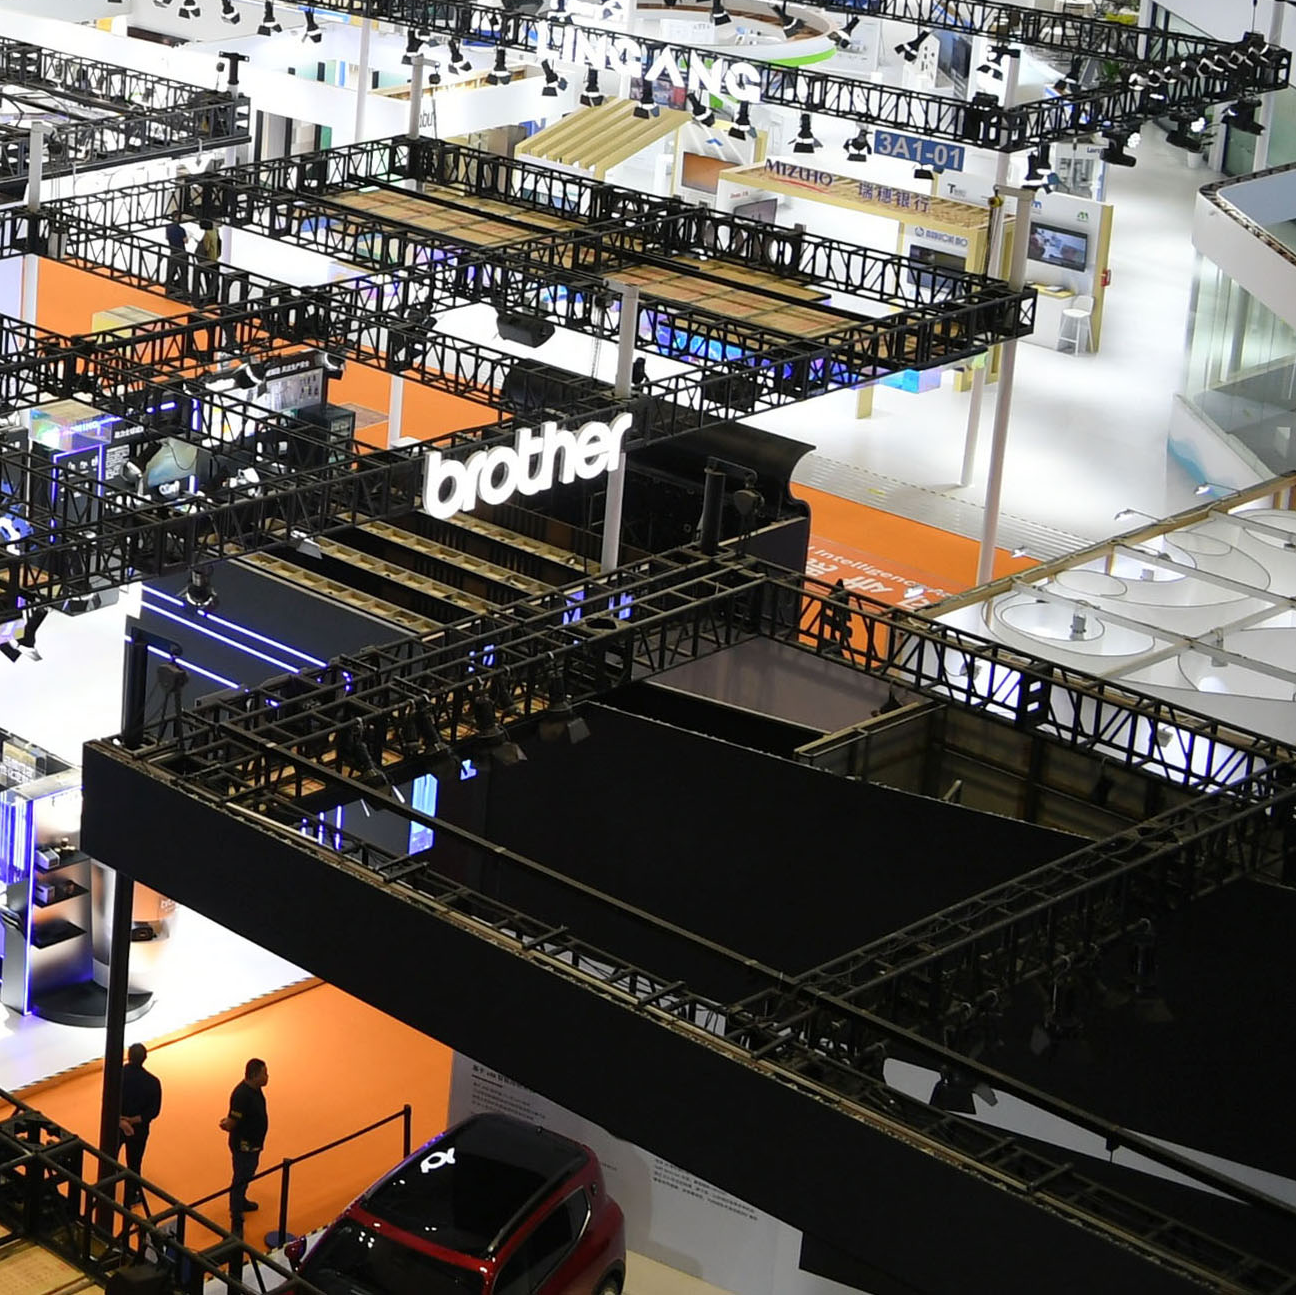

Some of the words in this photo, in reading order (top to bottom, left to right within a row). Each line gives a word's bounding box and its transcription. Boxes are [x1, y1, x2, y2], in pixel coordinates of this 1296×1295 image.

[536, 19, 762, 103] LINGANG
[878, 134, 963, 170] 3A1-01
[763, 158, 833, 187] MIZUHO
[422, 411, 634, 520] brother
[814, 548, 919, 588] Intelligenc
